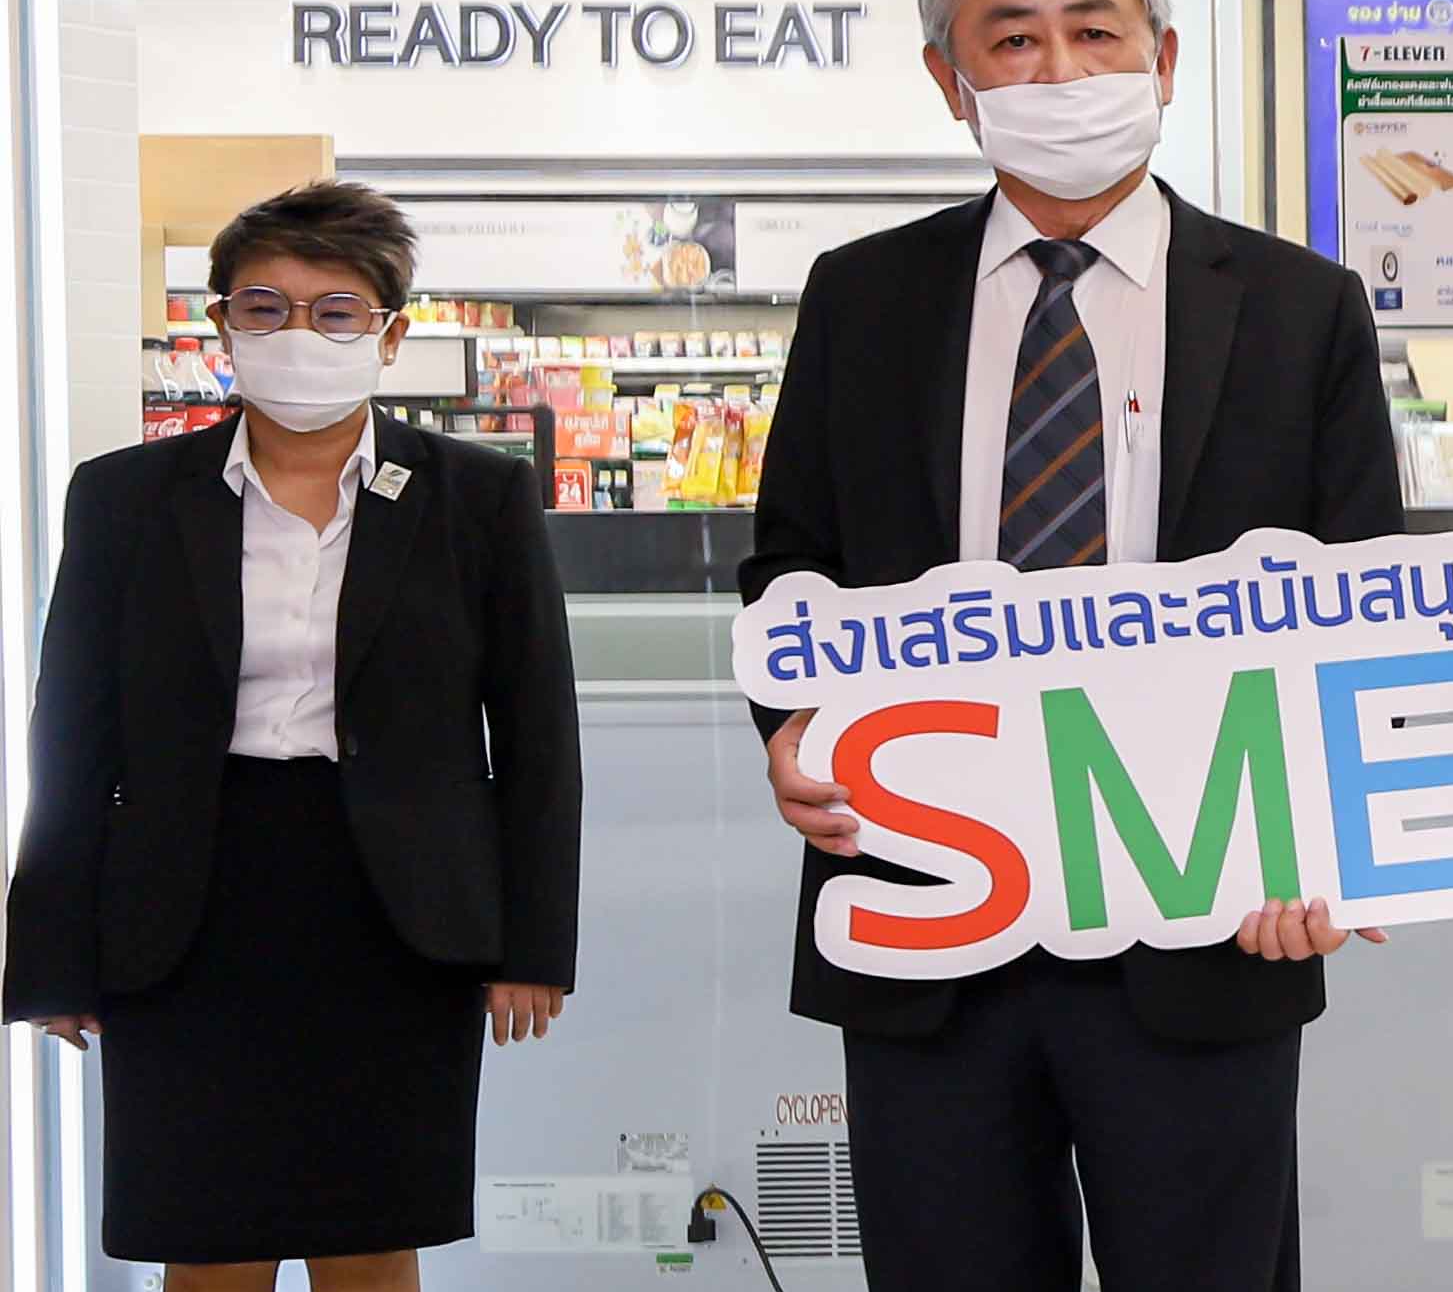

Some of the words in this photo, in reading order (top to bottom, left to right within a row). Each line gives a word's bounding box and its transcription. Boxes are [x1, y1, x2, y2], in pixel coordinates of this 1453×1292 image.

[292, 1, 569, 69] READY
[581, 1, 698, 69] TO
[714, 1, 868, 69] EAT
[558, 482, 582, 503] 24
